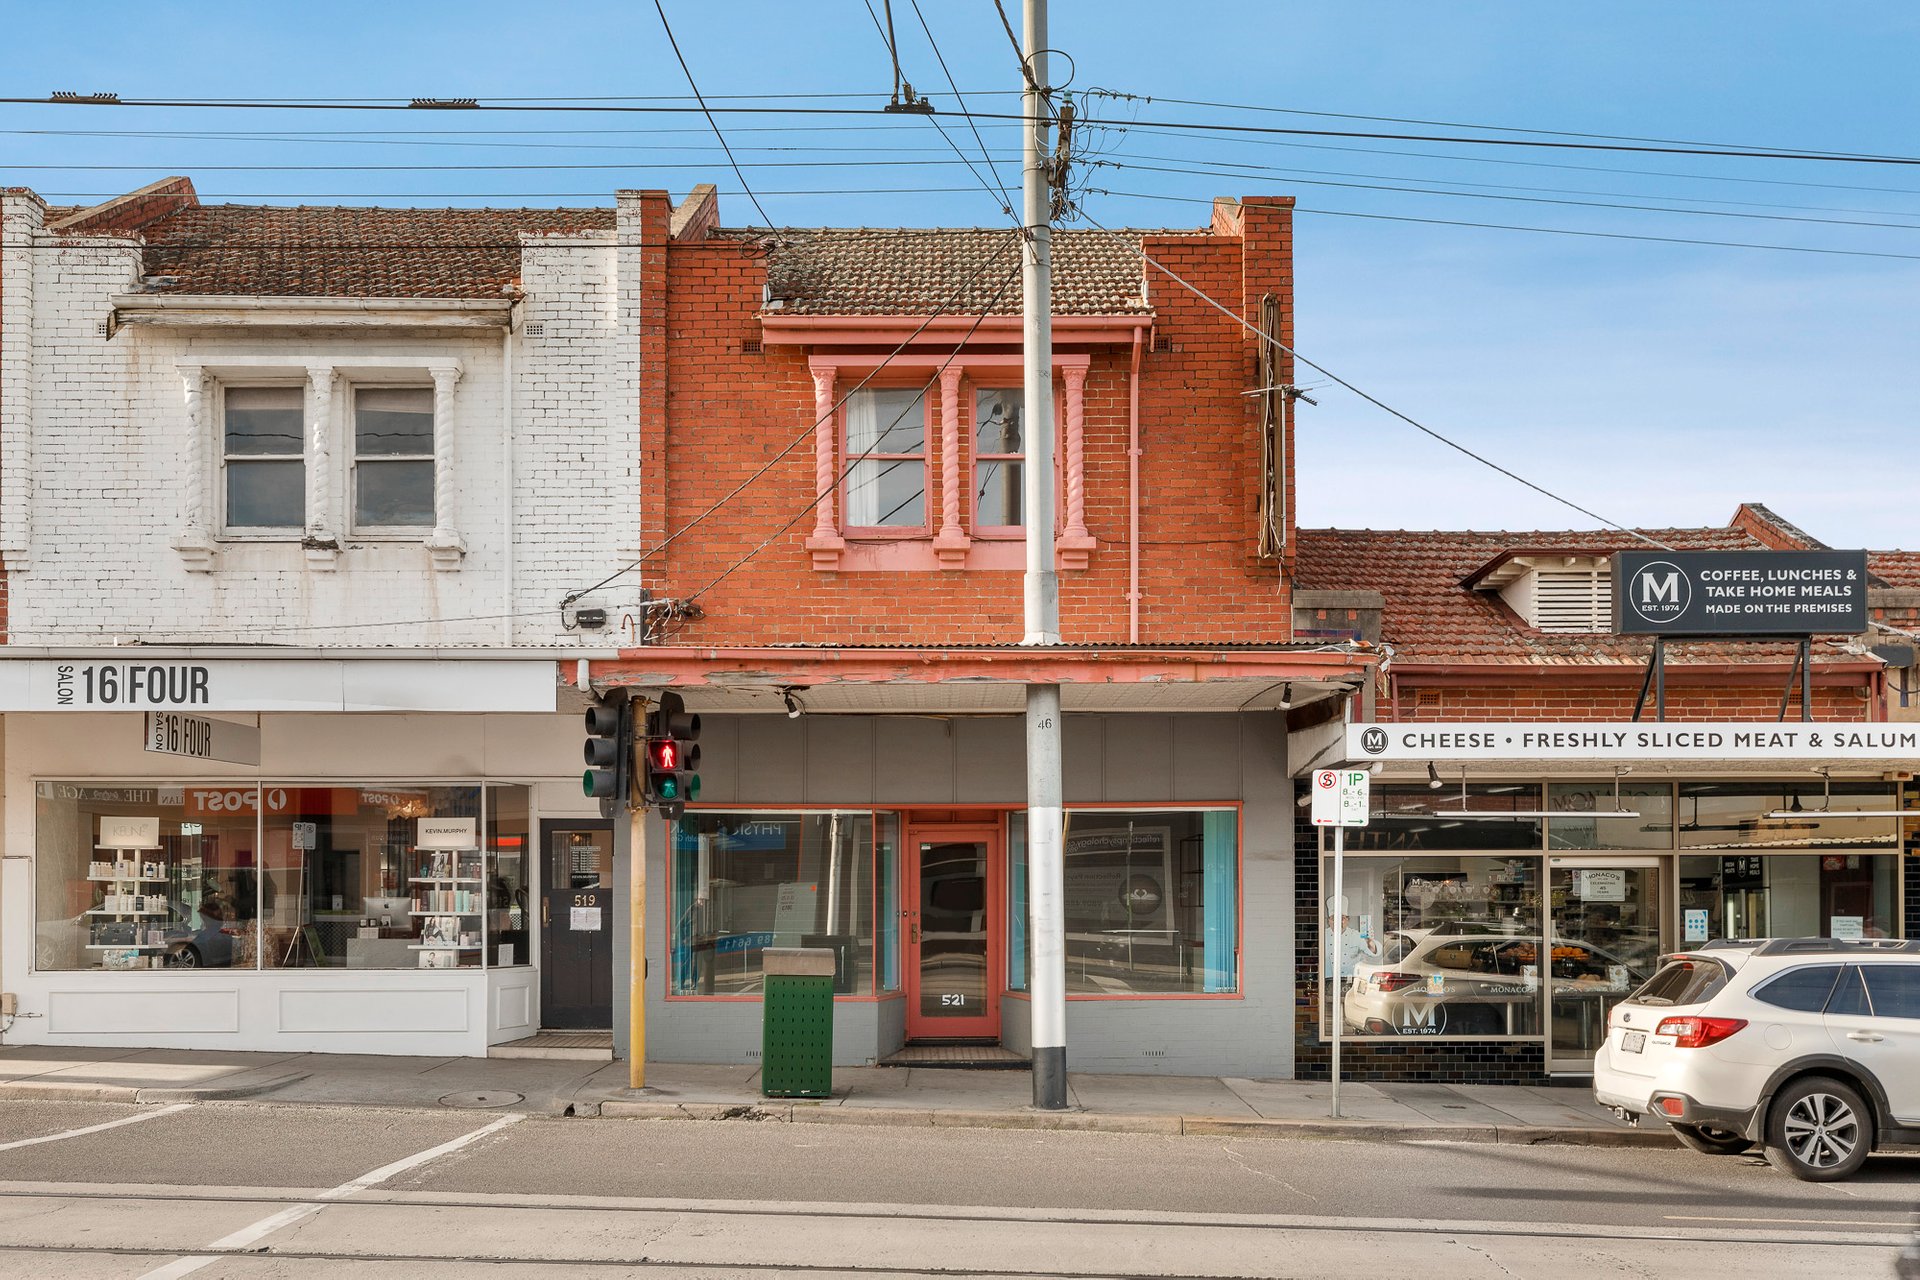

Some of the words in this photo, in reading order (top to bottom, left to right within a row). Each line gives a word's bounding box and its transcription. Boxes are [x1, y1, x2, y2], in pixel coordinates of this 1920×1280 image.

[1700, 569, 1764, 583] COFFEE,
[1768, 569, 1842, 581] LUNCHES
[1846, 569, 1857, 581] &
[1641, 572, 1679, 603] M
[1705, 586, 1745, 597] TAKE
[1750, 585, 1796, 597] HOME
[1801, 585, 1852, 597] MEALS
[1641, 604, 1660, 612] EST.
[1661, 604, 1680, 612] 1974
[1705, 604, 1741, 614] MADE
[1744, 604, 1764, 613] ON
[1765, 604, 1791, 613] THE
[1794, 603, 1852, 613] PREMISES
[57, 665, 74, 705] SALON
[155, 711, 164, 750] SALON
[1037, 718, 1053, 730] 46
[1366, 732, 1383, 746] M
[1402, 732, 1496, 748] CHEESE
[1523, 732, 1628, 748] FRESHLY
[1637, 732, 1723, 748] SLICED
[1734, 732, 1798, 748] MEAT
[1808, 732, 1824, 748] &
[1833, 732, 1917, 748] SALUM
[1347, 773, 1364, 786] 1P
[574, 894, 596, 907] 519
[941, 994, 965, 1006] 521
[1402, 1001, 1437, 1027] M
